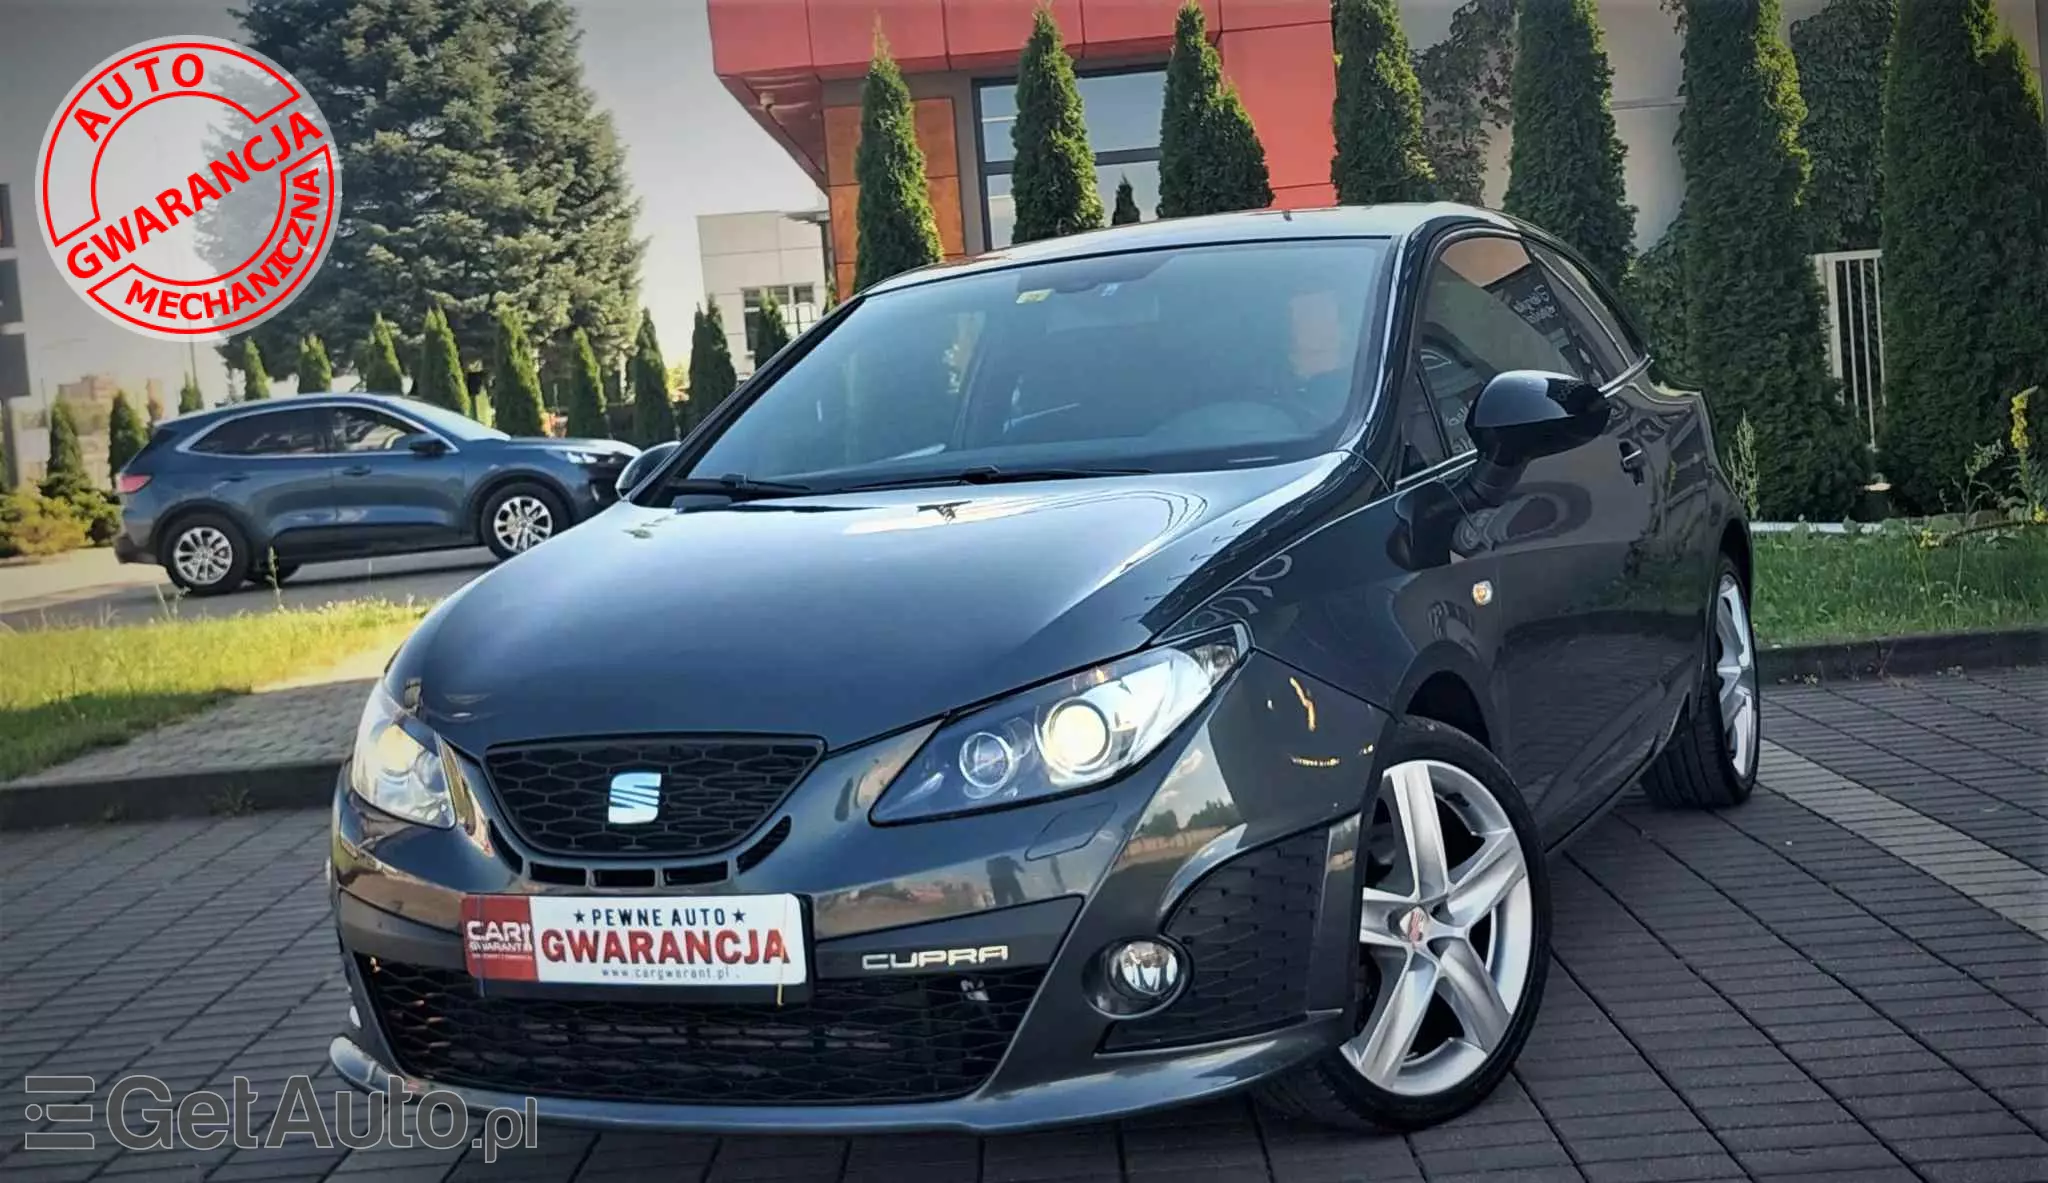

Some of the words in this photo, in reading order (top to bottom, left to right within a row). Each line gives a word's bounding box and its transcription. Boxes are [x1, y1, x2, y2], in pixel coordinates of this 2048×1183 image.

[592, 908, 662, 927] PEWNE
[671, 908, 726, 926] AUTO
[540, 928, 790, 965] GWARANCJA
[862, 945, 1009, 970] CUPRA
